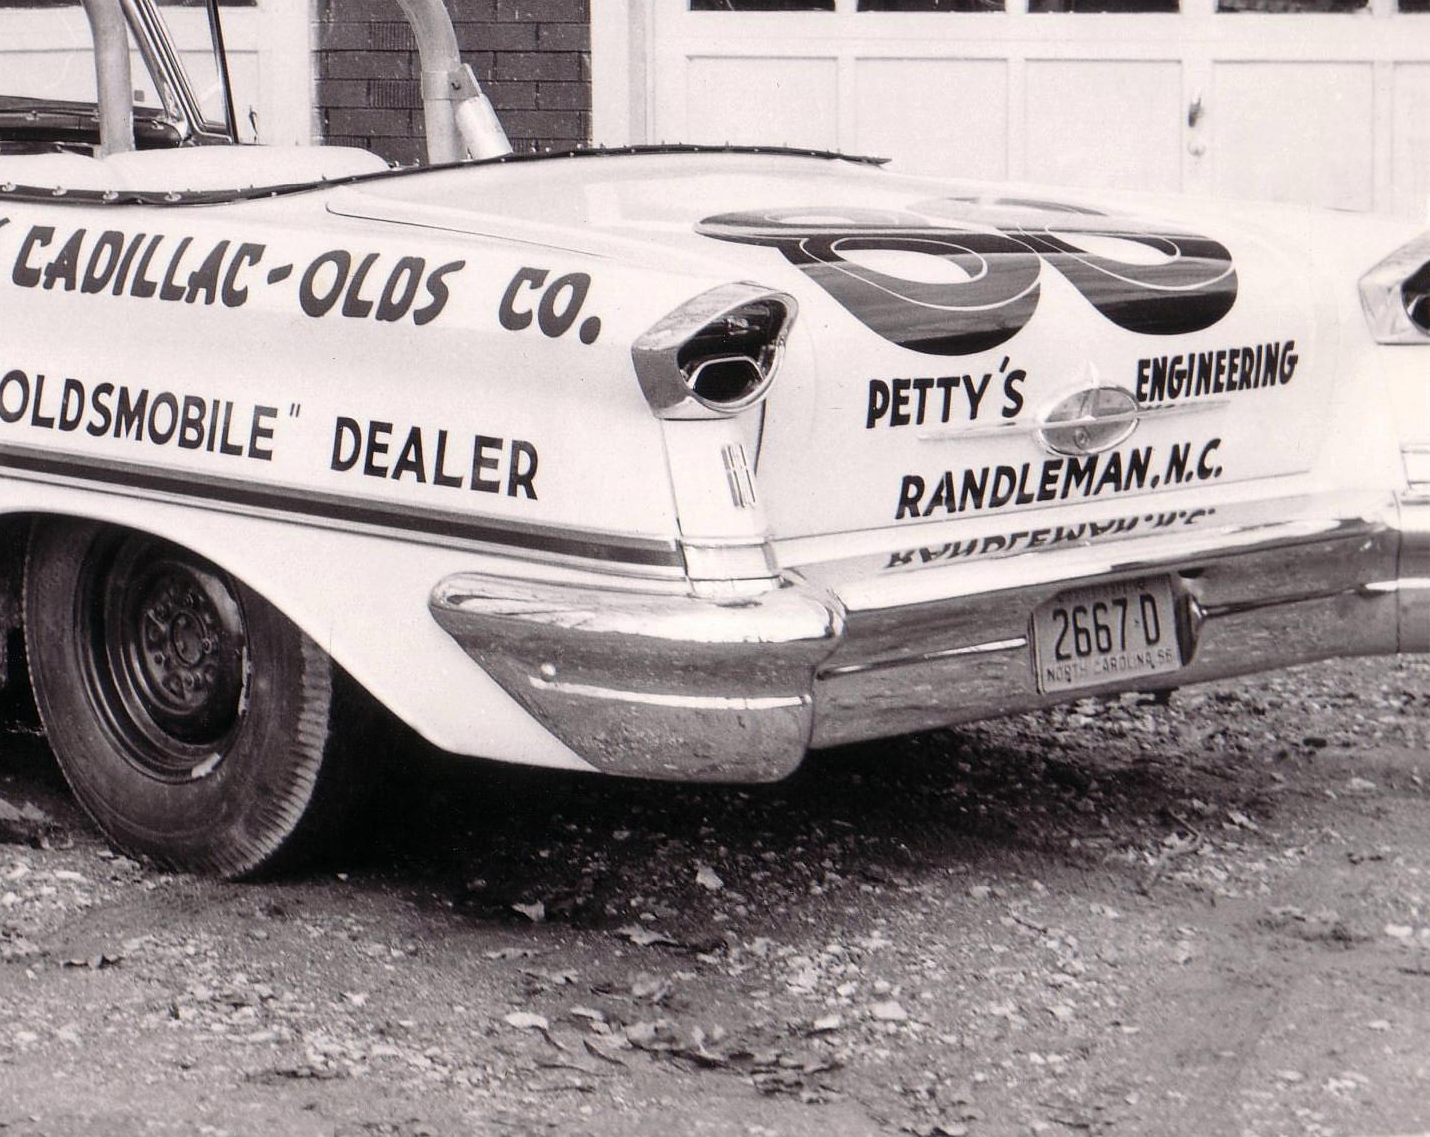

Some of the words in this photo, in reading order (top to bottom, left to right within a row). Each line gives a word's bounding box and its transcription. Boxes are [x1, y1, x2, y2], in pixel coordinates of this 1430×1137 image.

[498, 267, 602, 346] CO.
[865, 355, 1027, 429] PETTY'S
[1135, 339, 1299, 403] ENGINEERING
[330, 416, 539, 501] DEALER
